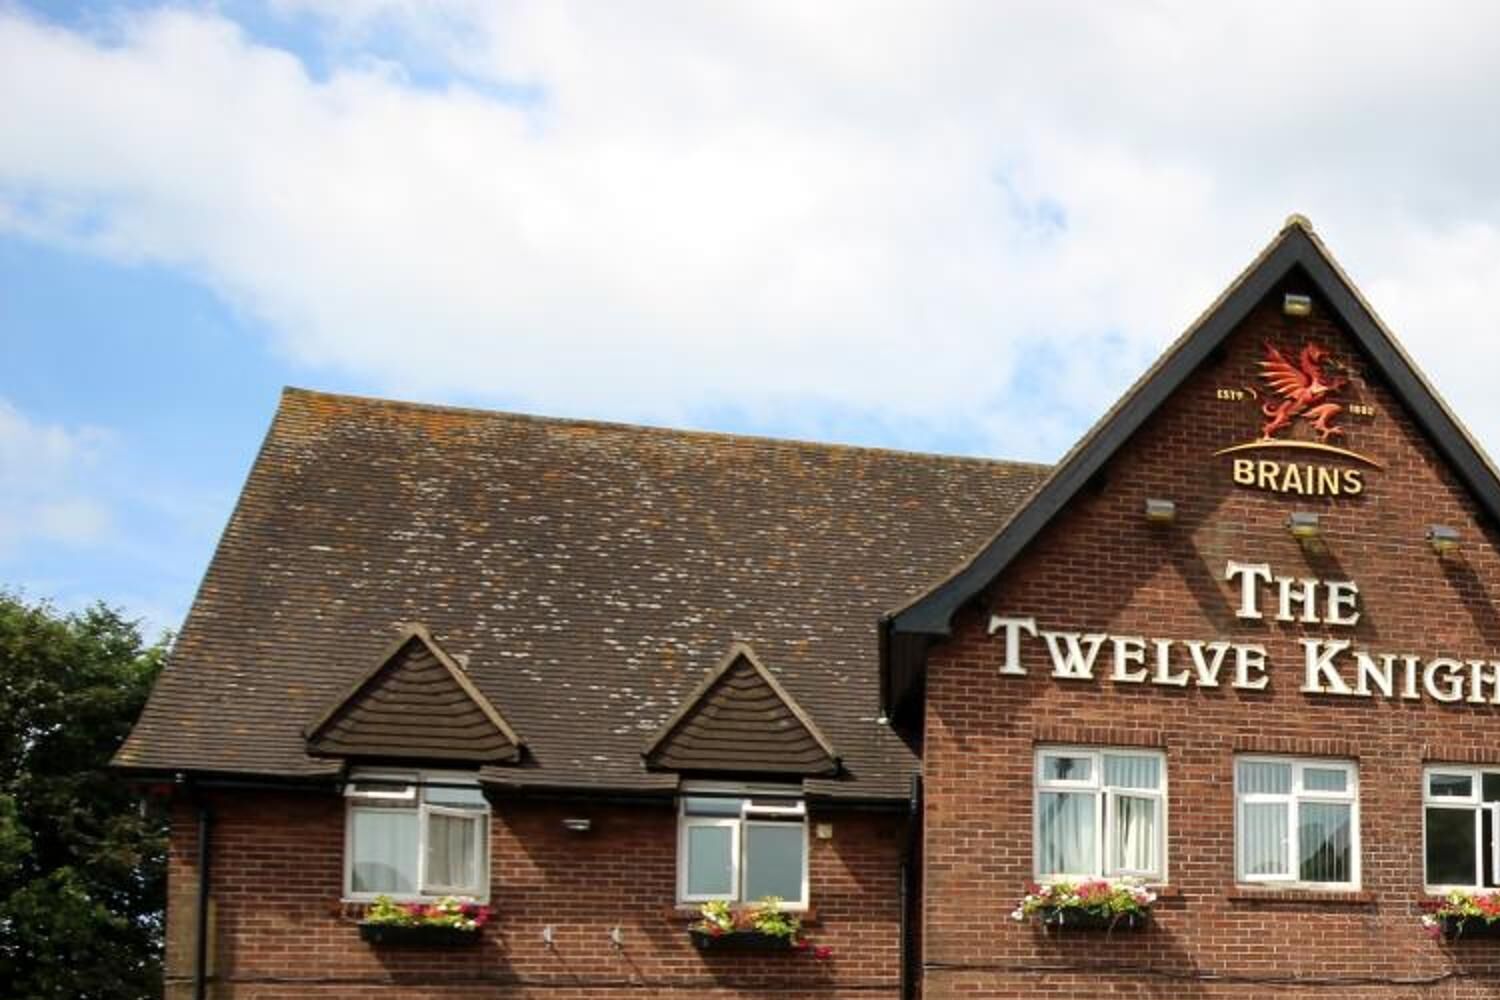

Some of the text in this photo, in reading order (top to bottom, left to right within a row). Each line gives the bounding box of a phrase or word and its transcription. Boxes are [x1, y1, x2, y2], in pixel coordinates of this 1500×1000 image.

[1233, 459, 1363, 496] BRAINS
[1225, 560, 1361, 626] THE
[988, 616, 1270, 690] TWELVE
